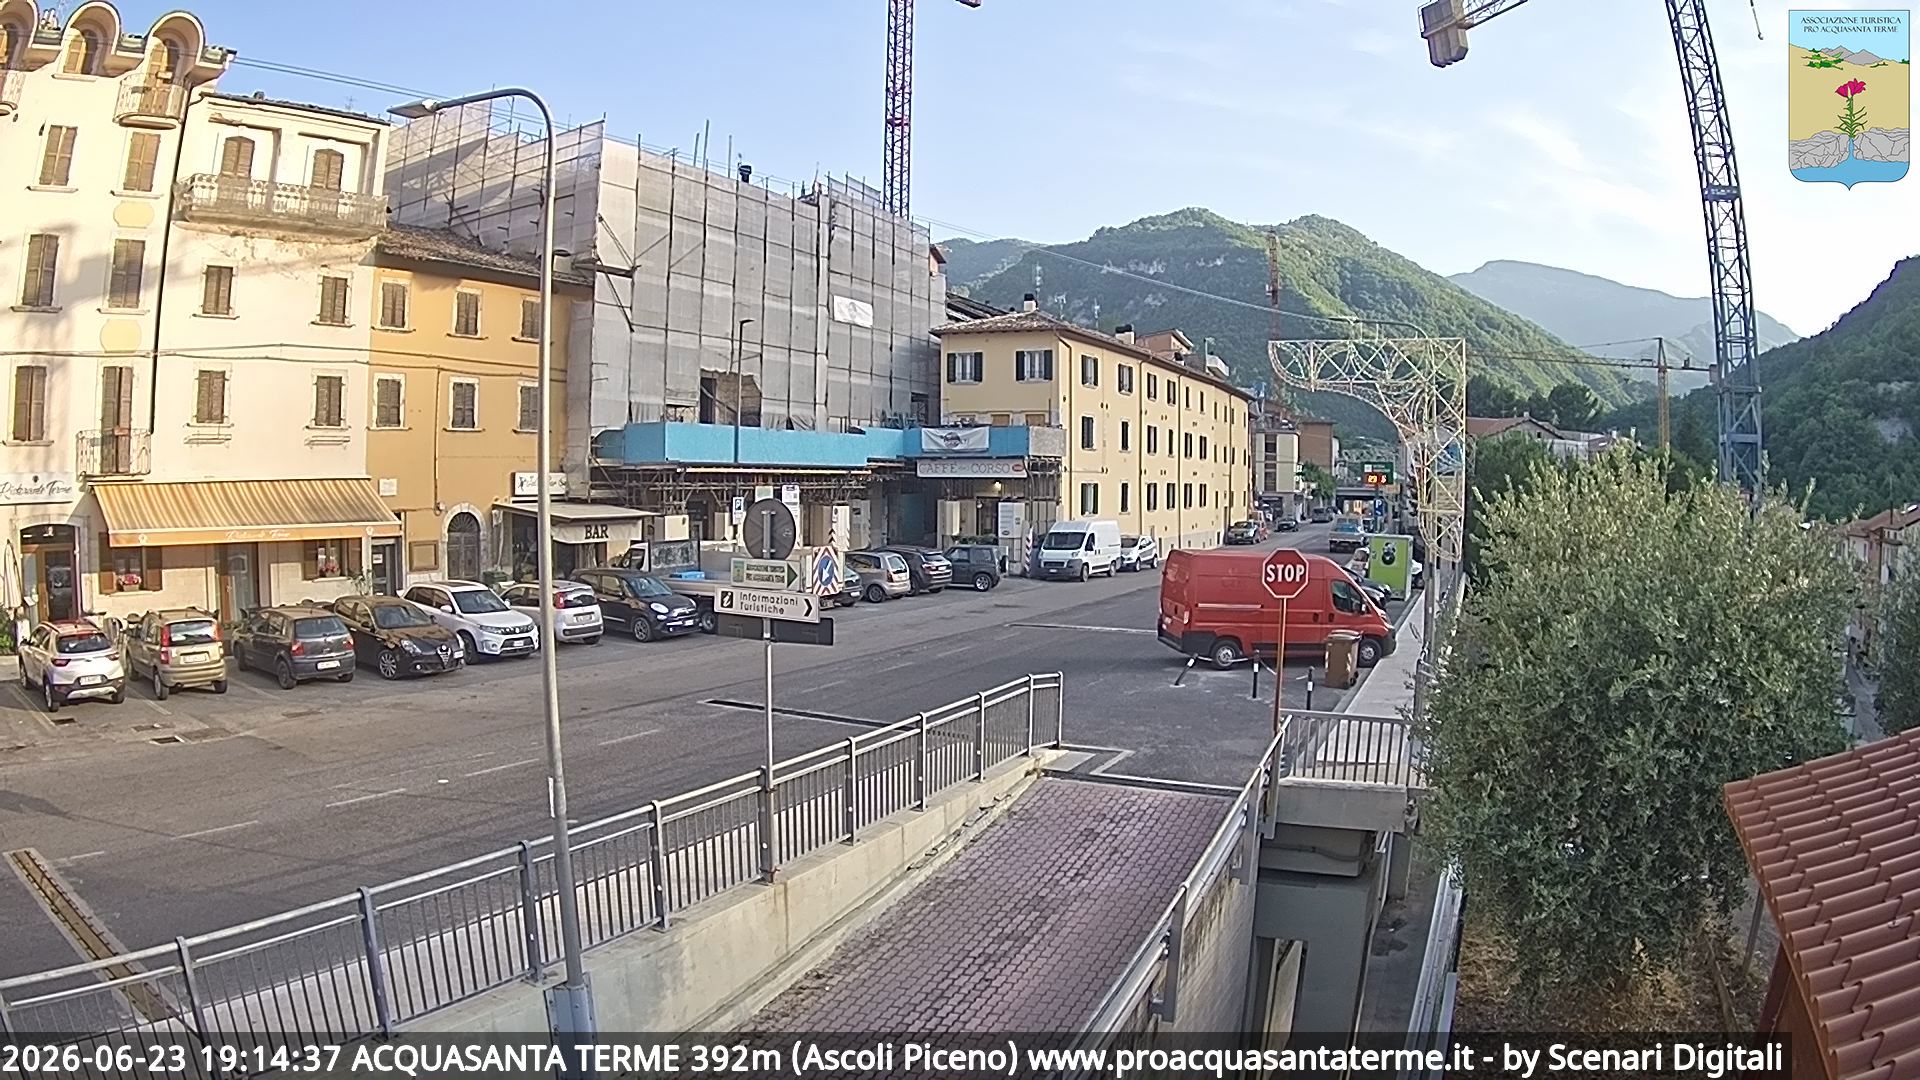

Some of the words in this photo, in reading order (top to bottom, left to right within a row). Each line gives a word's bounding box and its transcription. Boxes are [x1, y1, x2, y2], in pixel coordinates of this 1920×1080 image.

[970, 463, 1010, 474] CORSO
[584, 524, 609, 540] BAR
[1266, 564, 1305, 583] STOP
[740, 591, 799, 606] Informazioni
[740, 601, 785, 615] Turistiche
